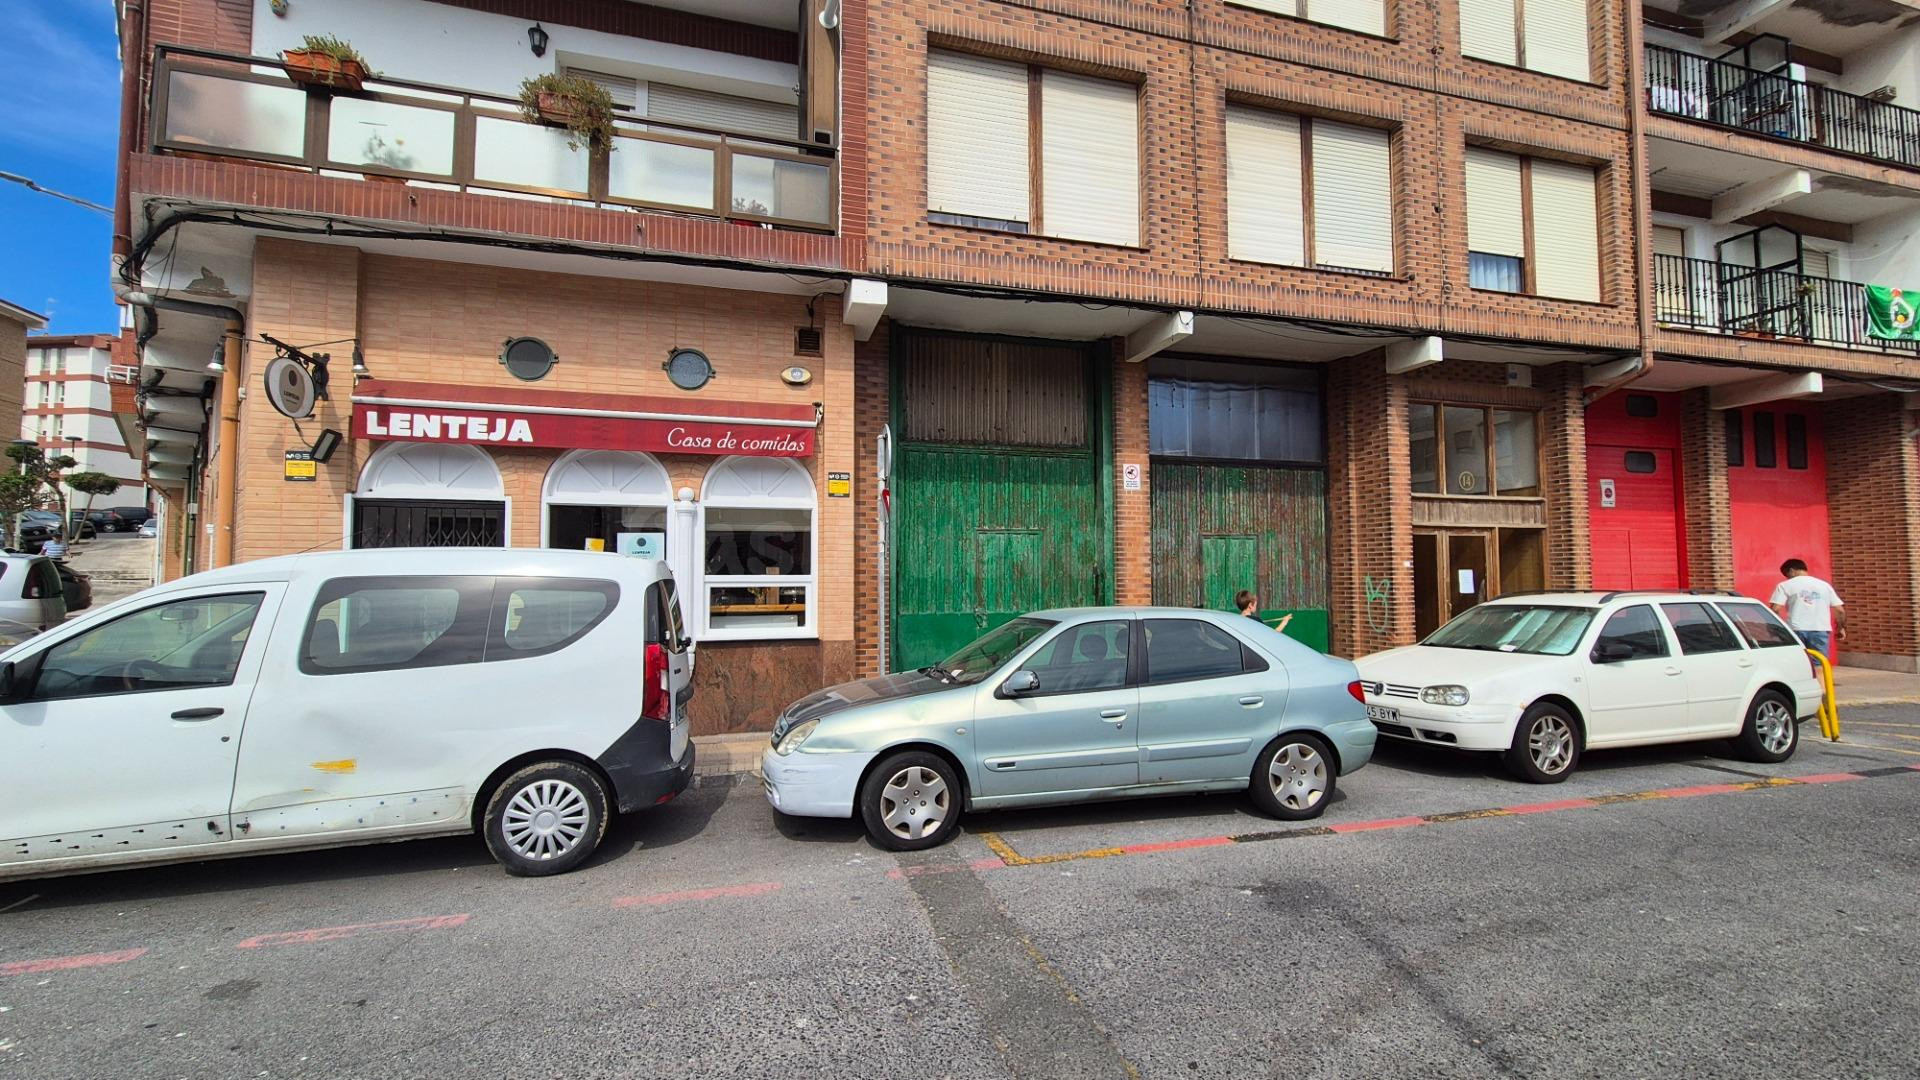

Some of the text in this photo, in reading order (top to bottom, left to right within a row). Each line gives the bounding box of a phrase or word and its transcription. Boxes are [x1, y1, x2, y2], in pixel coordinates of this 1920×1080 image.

[366, 411, 534, 443] LENTEJA
[667, 427, 806, 452] Casa de comidas
